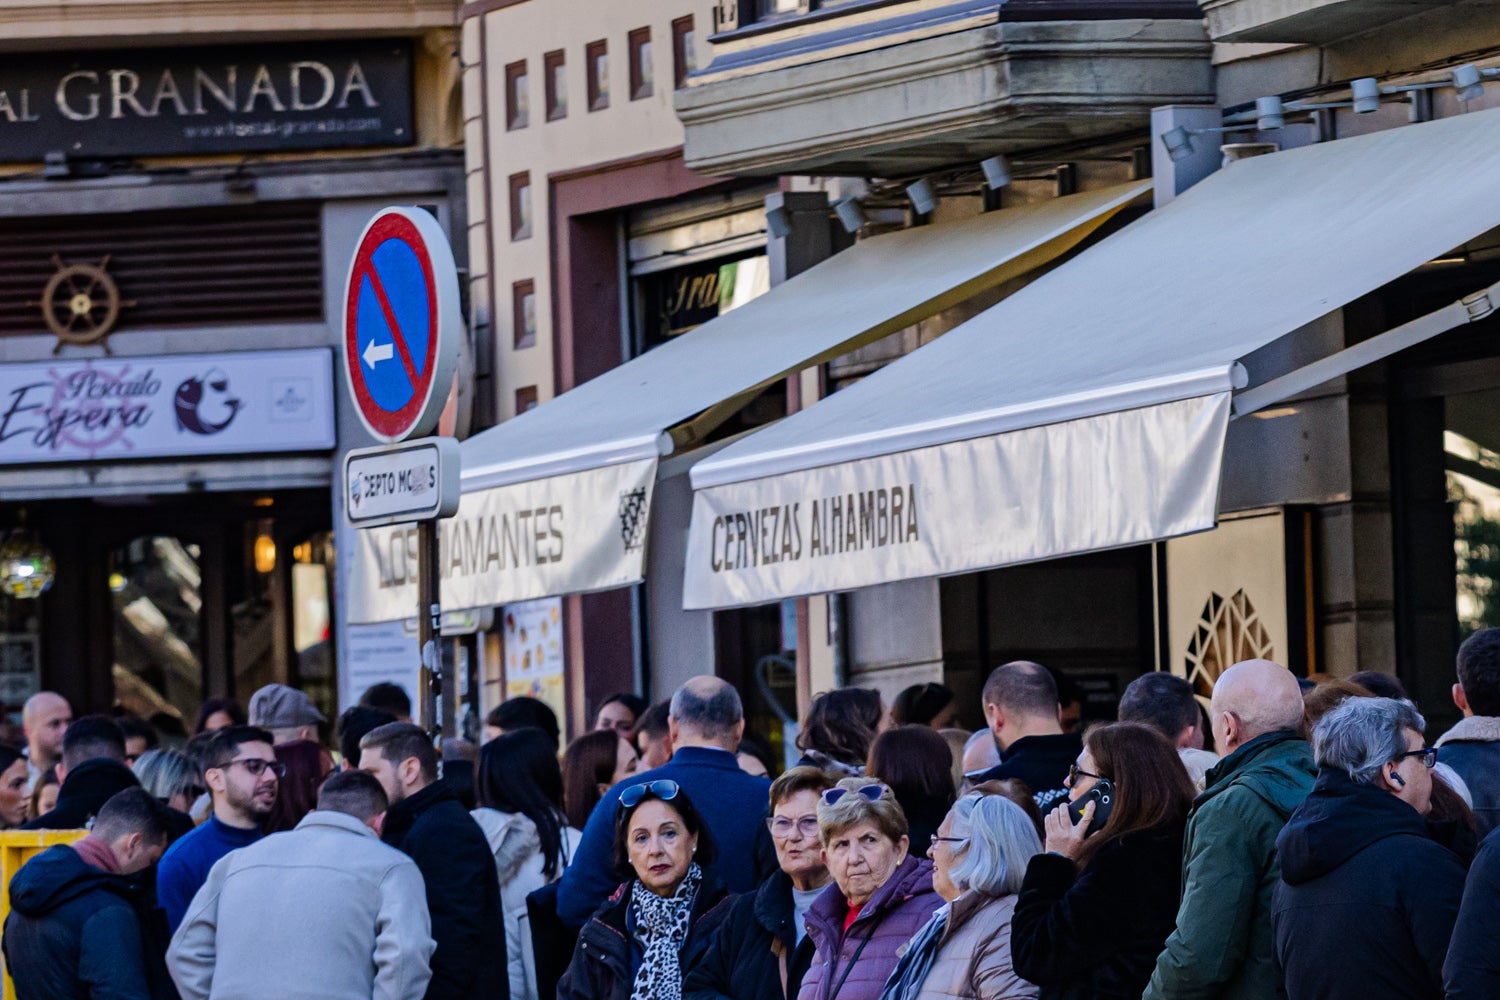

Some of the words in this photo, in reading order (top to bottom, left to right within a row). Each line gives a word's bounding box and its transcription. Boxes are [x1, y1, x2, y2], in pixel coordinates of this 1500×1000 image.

[55, 60, 381, 121] GRANADA
[439, 504, 564, 581] IAMANTES
[711, 502, 803, 573] CERVEZAS
[810, 483, 919, 558] ALHAMBRA
